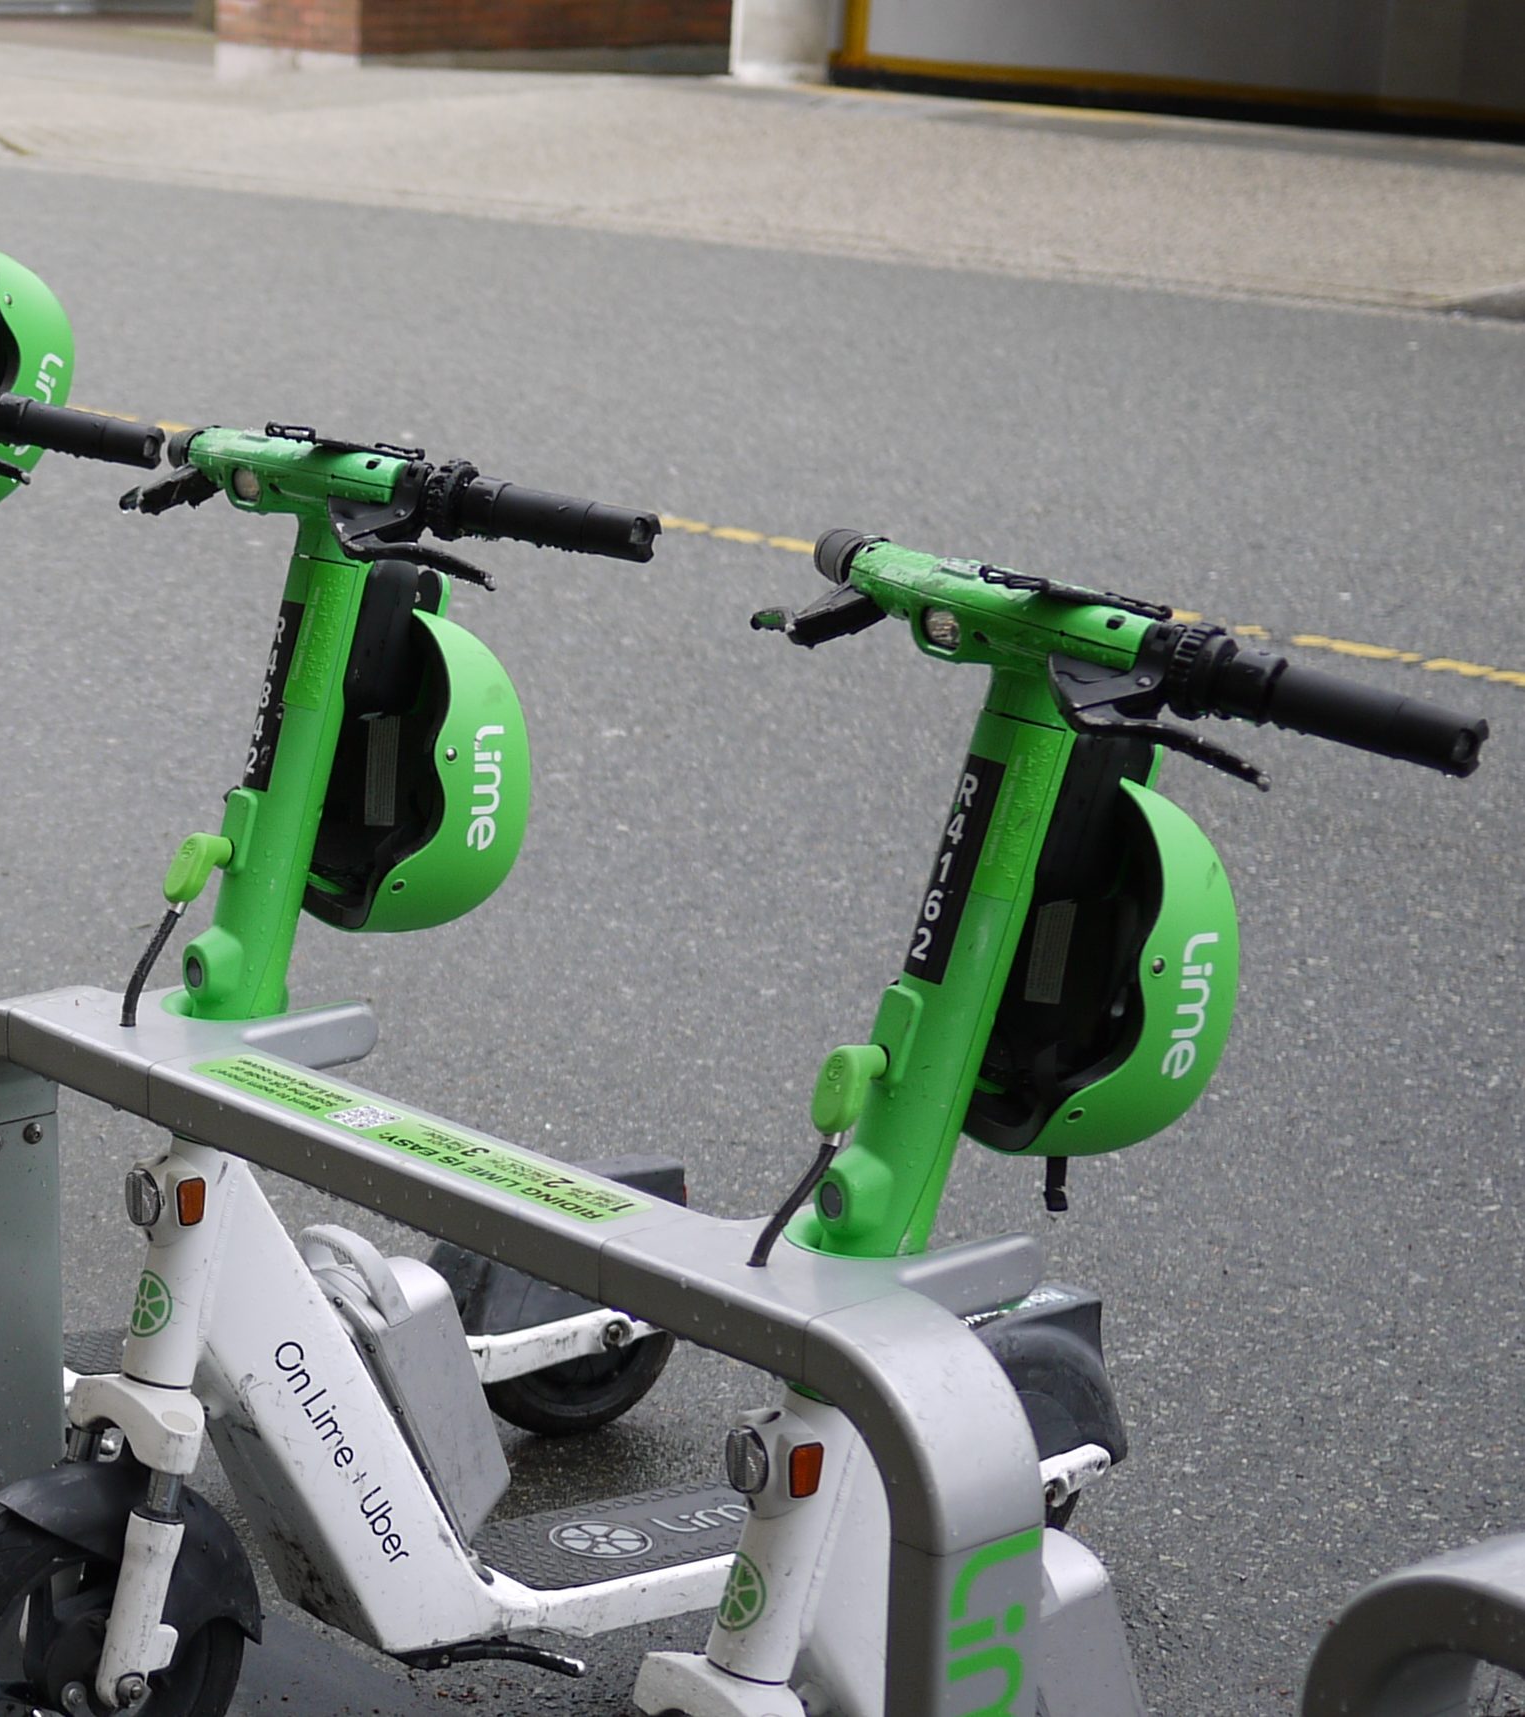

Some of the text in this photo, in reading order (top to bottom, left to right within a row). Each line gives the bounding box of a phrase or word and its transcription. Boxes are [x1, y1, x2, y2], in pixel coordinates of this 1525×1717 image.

[245, 616, 286, 775] R4842
[467, 725, 504, 851] Lime
[911, 773, 979, 961] R4162
[1161, 932, 1219, 1079] Lime
[378, 1132, 440, 1157] EASY:
[460, 1147, 491, 1157] 3
[437, 1155, 466, 1166] IS
[462, 1164, 521, 1188] LIME
[542, 1177, 575, 1188] 2
[520, 1187, 604, 1219] RIDING
[608, 1202, 636, 1212] 1
[275, 1341, 311, 1394] On
[302, 1388, 354, 1468] Lime
[360, 1486, 409, 1563] Uber
[651, 1504, 749, 1532] Lim
